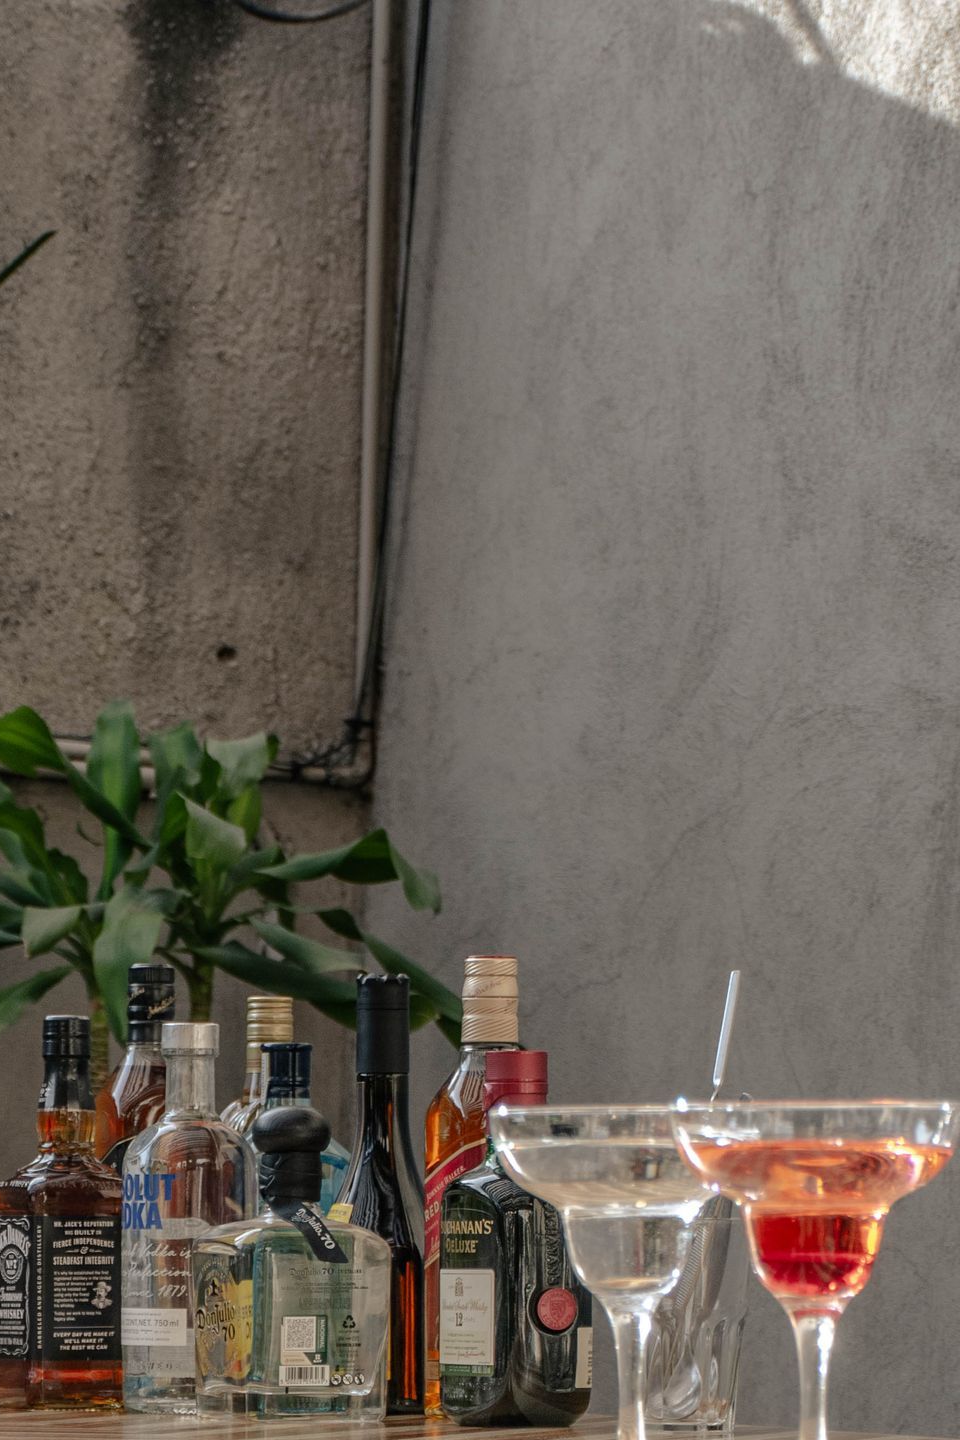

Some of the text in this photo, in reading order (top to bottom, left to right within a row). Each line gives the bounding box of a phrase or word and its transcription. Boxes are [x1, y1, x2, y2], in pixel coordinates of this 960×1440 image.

[424, 1201, 440, 1222] RED
[52, 1237, 115, 1249] FIERCE INDEPENDENCE
[321, 1233, 336, 1250] 70
[52, 1256, 115, 1266] STEADFAST INTEGRITY
[154, 1319, 168, 1327] 750
[455, 1312, 463, 1327] 12
[222, 1323, 236, 1342] 70
